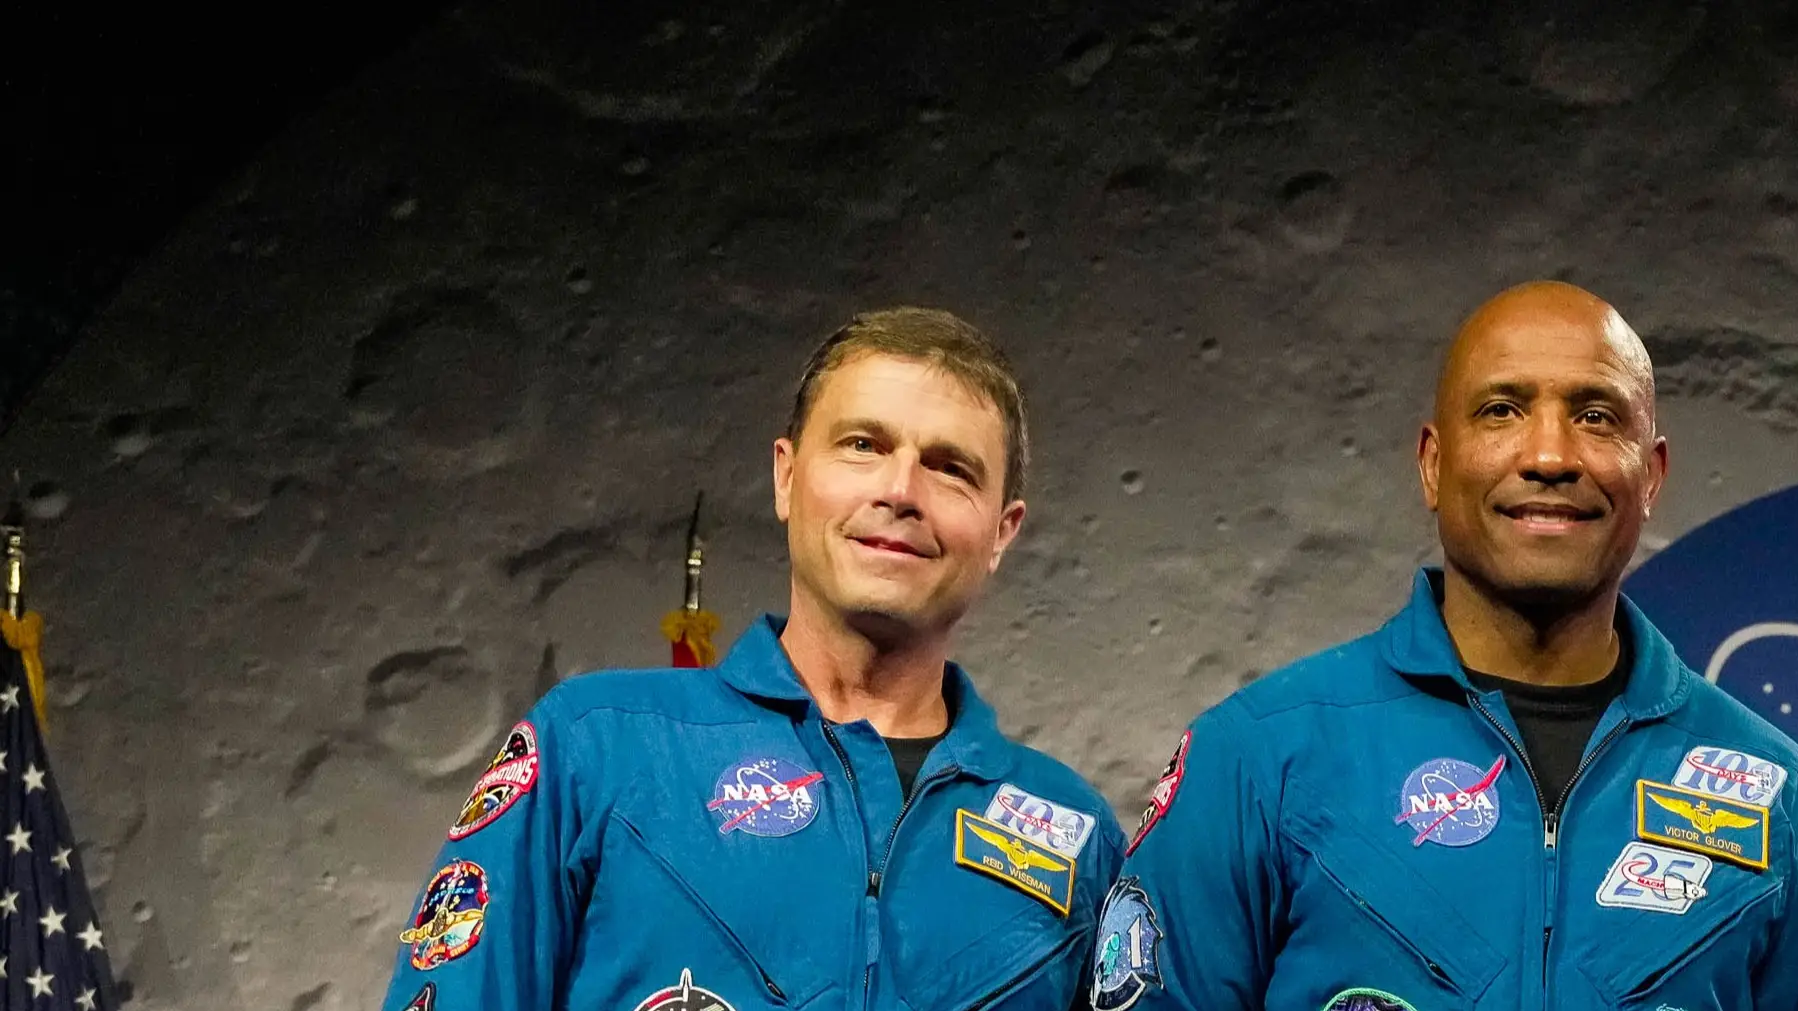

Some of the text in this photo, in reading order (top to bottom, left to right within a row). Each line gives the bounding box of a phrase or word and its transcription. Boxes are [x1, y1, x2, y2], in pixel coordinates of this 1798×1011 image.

[1717, 768, 1747, 783] DAYS
[723, 783, 813, 804] NASA
[1409, 792, 1495, 814] NASA
[1664, 825, 1742, 854] VICTOR GLOVER
[982, 855, 1052, 894] REID WISEMAN
[1613, 852, 1696, 901] 25
